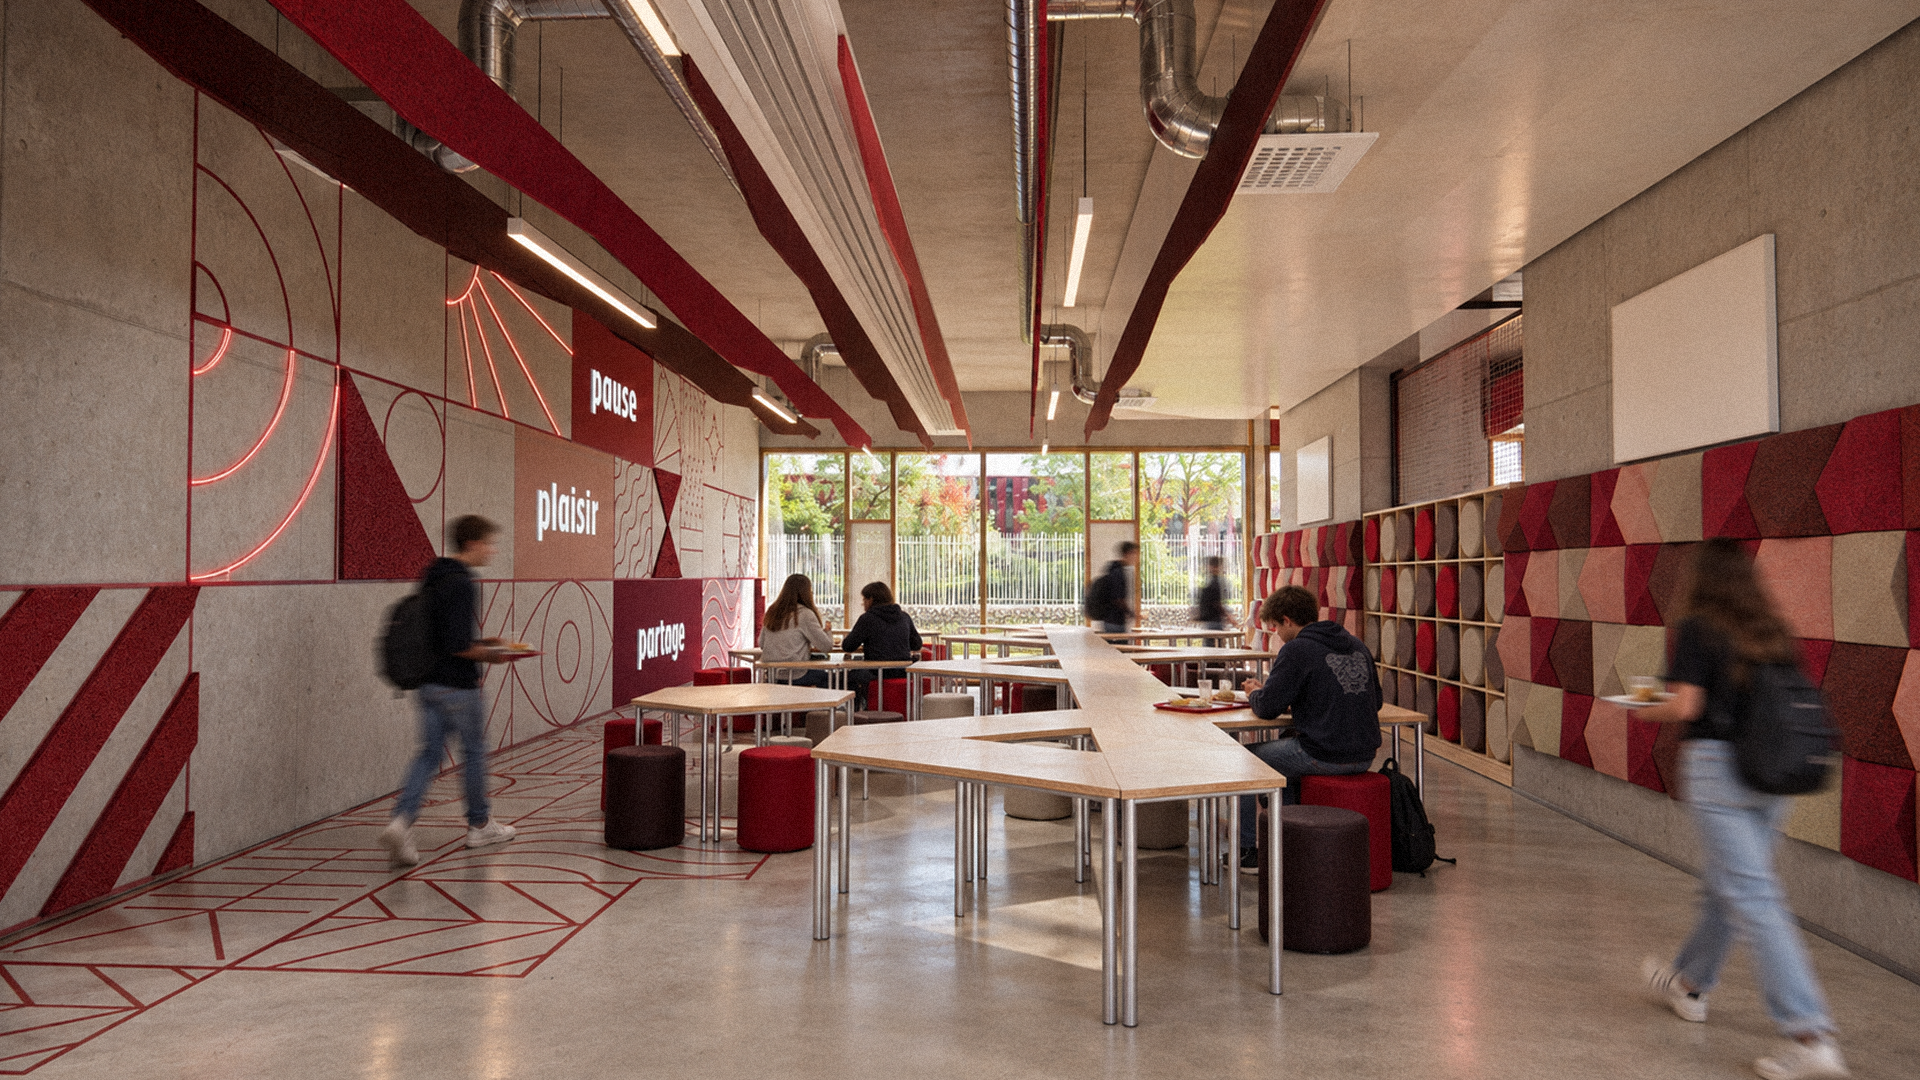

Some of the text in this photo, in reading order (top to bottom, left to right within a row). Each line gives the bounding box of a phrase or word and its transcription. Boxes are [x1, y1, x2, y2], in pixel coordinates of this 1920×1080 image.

[591, 369, 637, 422] pause
[536, 482, 599, 541] plaisir
[637, 620, 685, 670] partage
